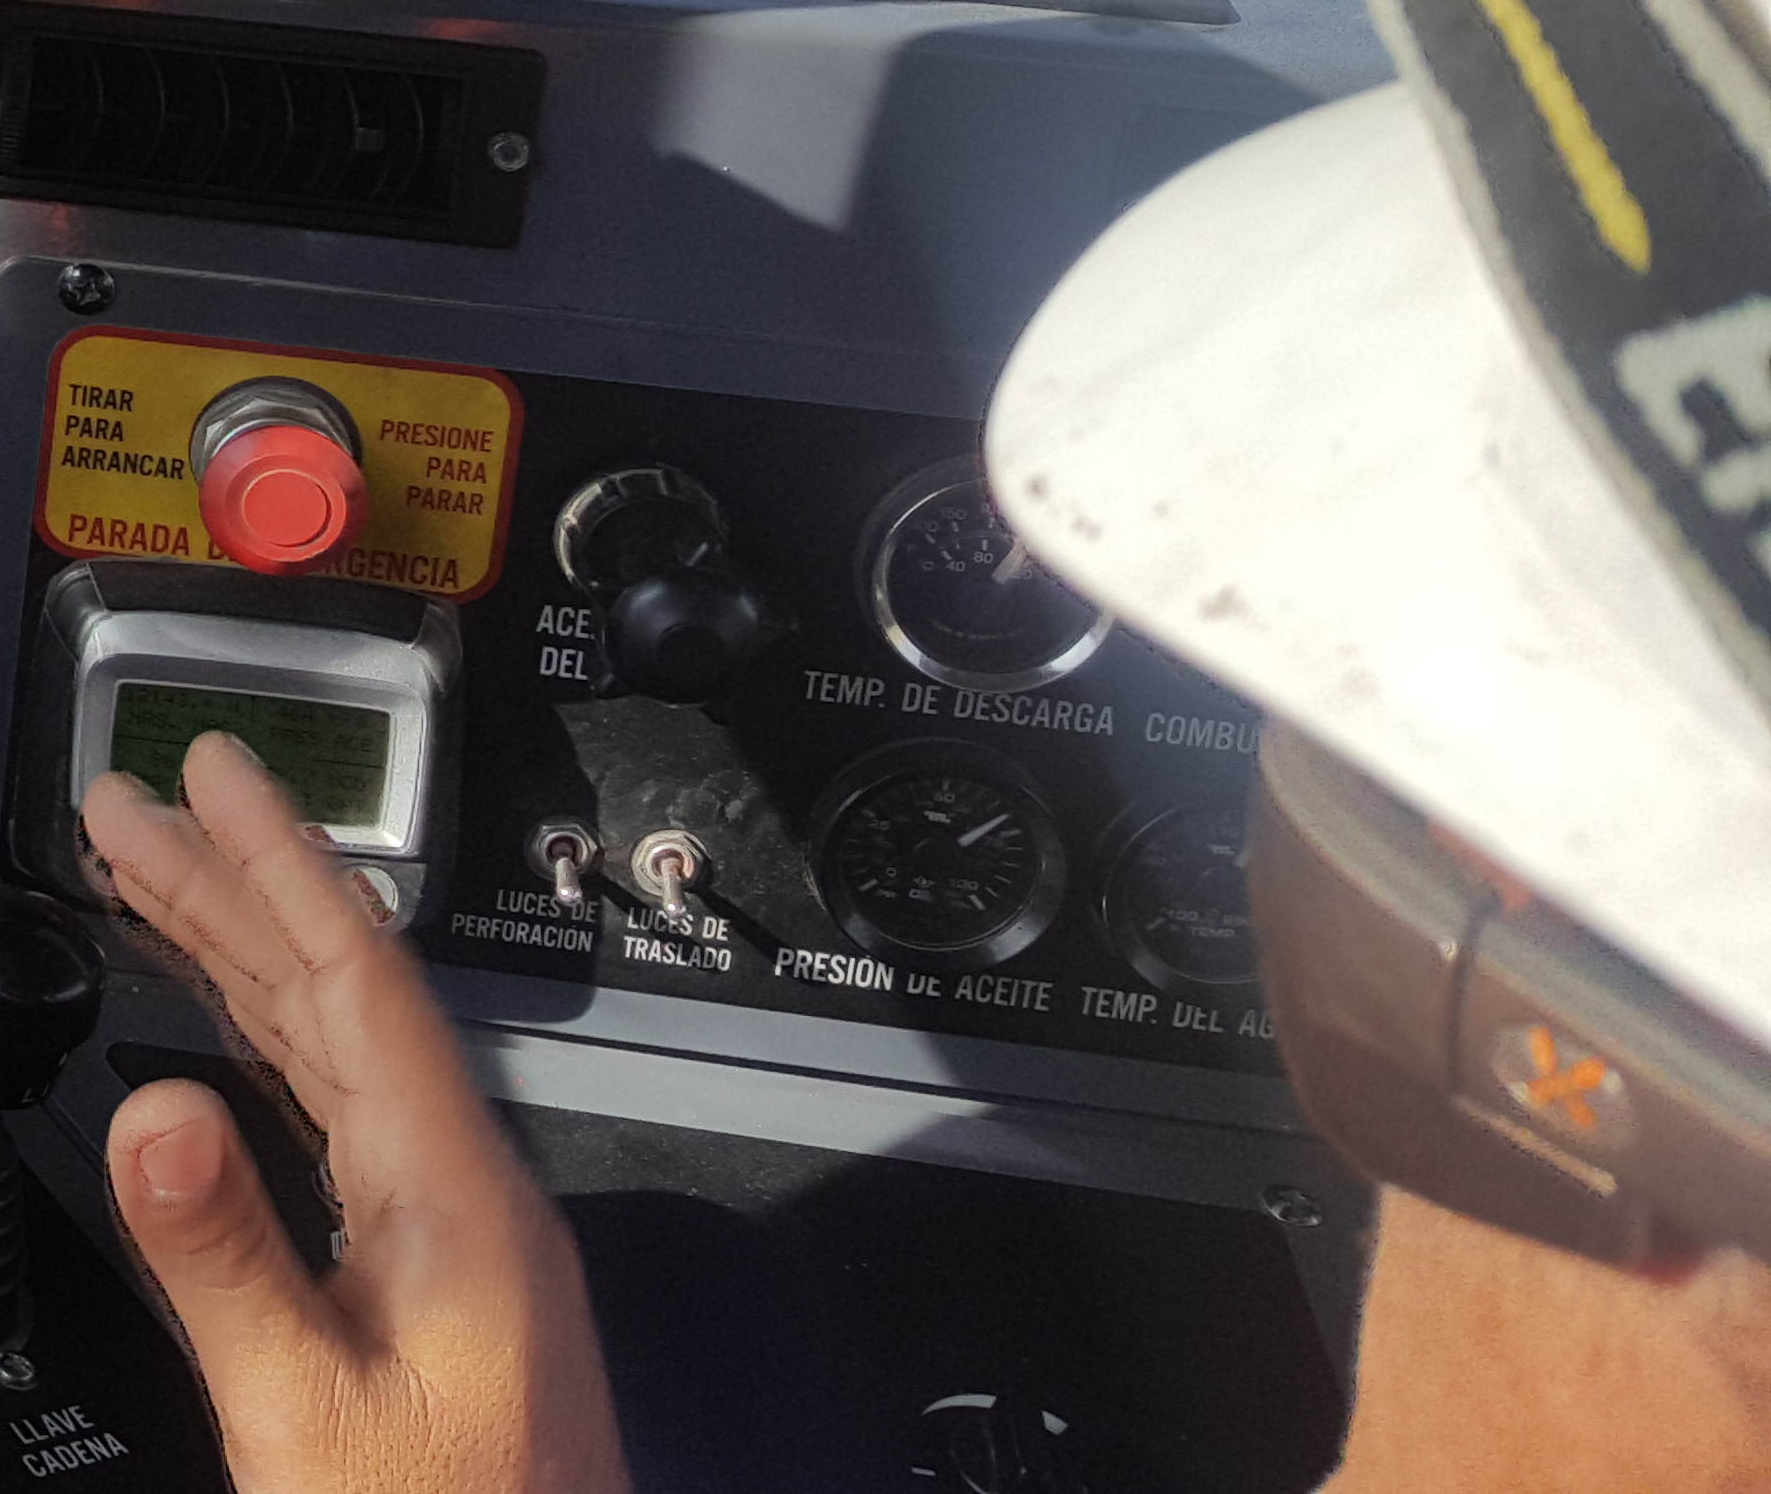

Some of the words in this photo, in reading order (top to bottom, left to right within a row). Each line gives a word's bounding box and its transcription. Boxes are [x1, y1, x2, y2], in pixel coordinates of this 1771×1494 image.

[68, 383, 134, 412] TIRAR
[64, 415, 124, 443] PARA
[379, 418, 493, 454] PRESIONE
[61, 444, 185, 481] ARRANCAR
[425, 456, 488, 484] PARA
[406, 484, 484, 516] PARAR
[67, 513, 190, 557] PARADA
[973, 551, 993, 564] 80
[539, 646, 589, 681] DEL
[804, 670, 885, 709] TEMP.
[902, 682, 939, 716] DE
[954, 691, 1114, 736] DESCARGA
[496, 889, 560, 918] LUCES
[571, 897, 596, 924] DE
[626, 907, 694, 937] LUCES
[702, 917, 730, 942] DE
[451, 911, 594, 953] PERFORACIÓN
[624, 934, 733, 972] TRASLADO
[775, 947, 894, 992] PRESIÓN
[954, 974, 1054, 1011] ACEITE
[1081, 986, 1157, 1024] TEMP.
[1172, 1002, 1224, 1034] DEL
[9, 1405, 96, 1446] LLAVE
[21, 1432, 130, 1480] CADENA
